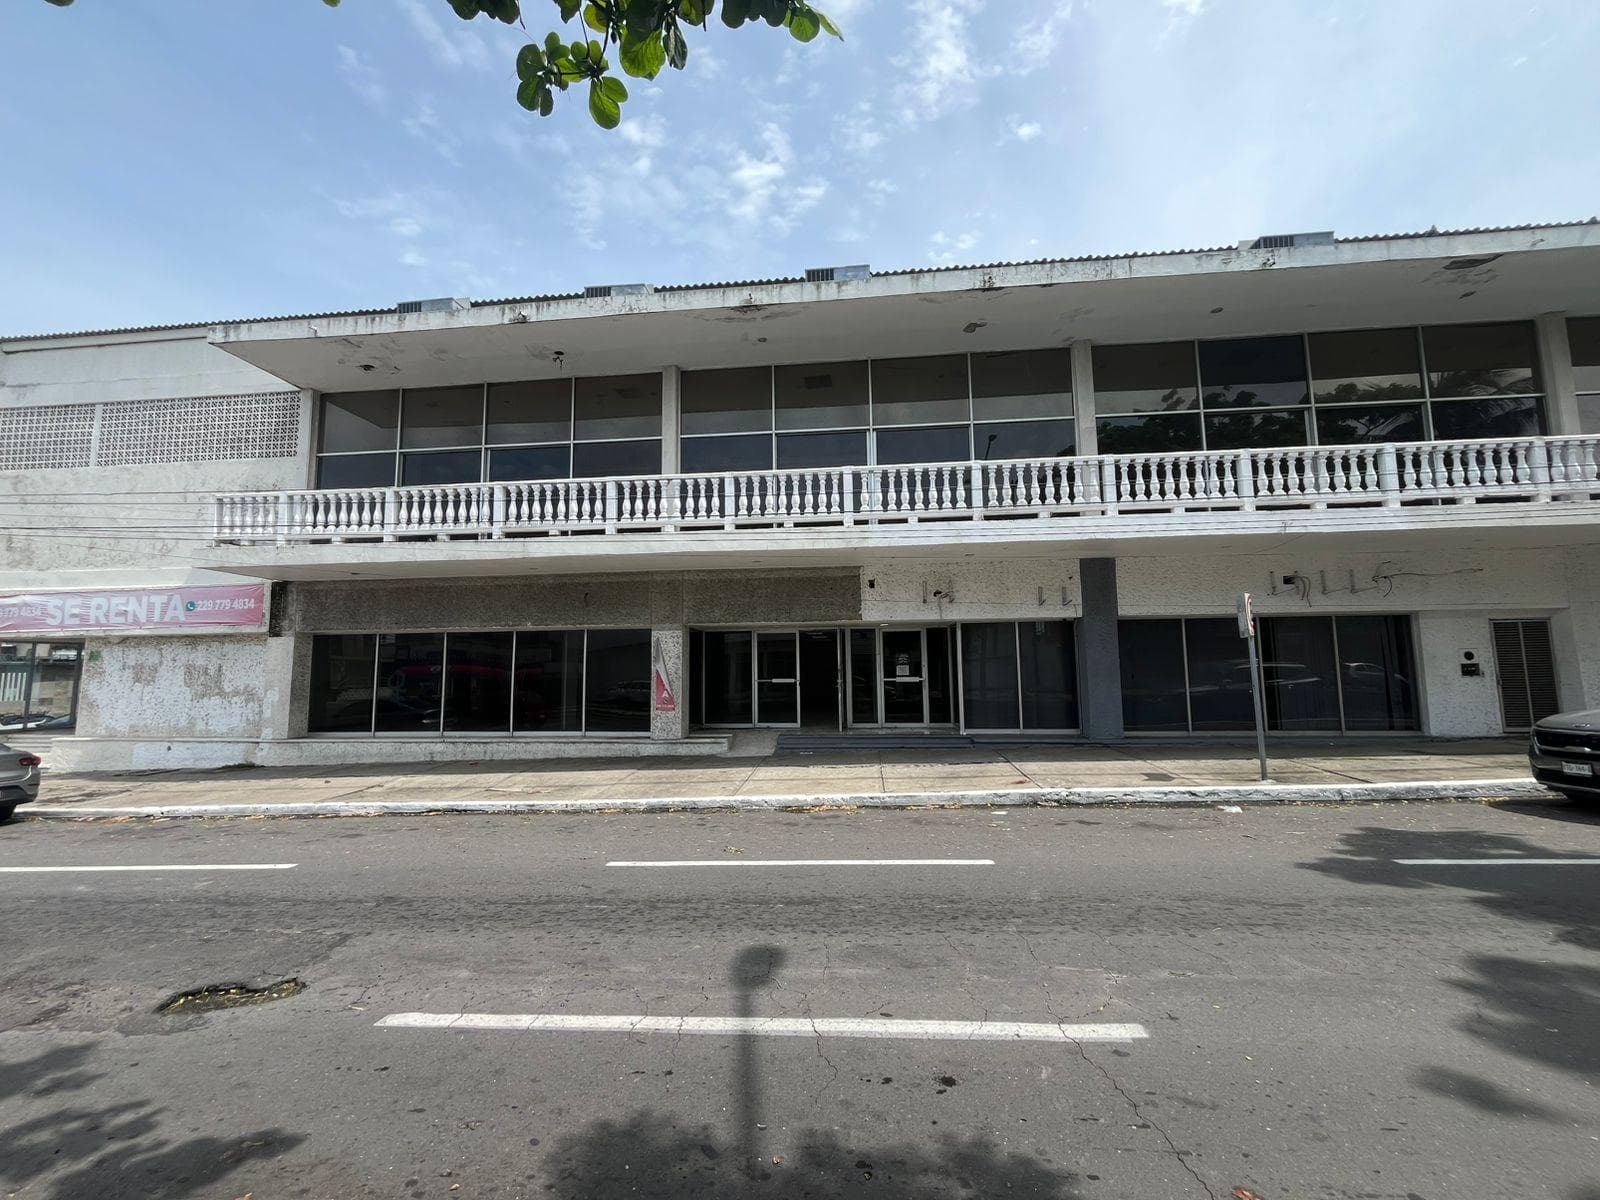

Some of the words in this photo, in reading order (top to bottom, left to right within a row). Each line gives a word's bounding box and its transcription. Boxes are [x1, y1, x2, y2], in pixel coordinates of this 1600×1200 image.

[46, 598, 80, 626] SE
[91, 593, 186, 624] RENTA
[232, 598, 255, 610] 4834
